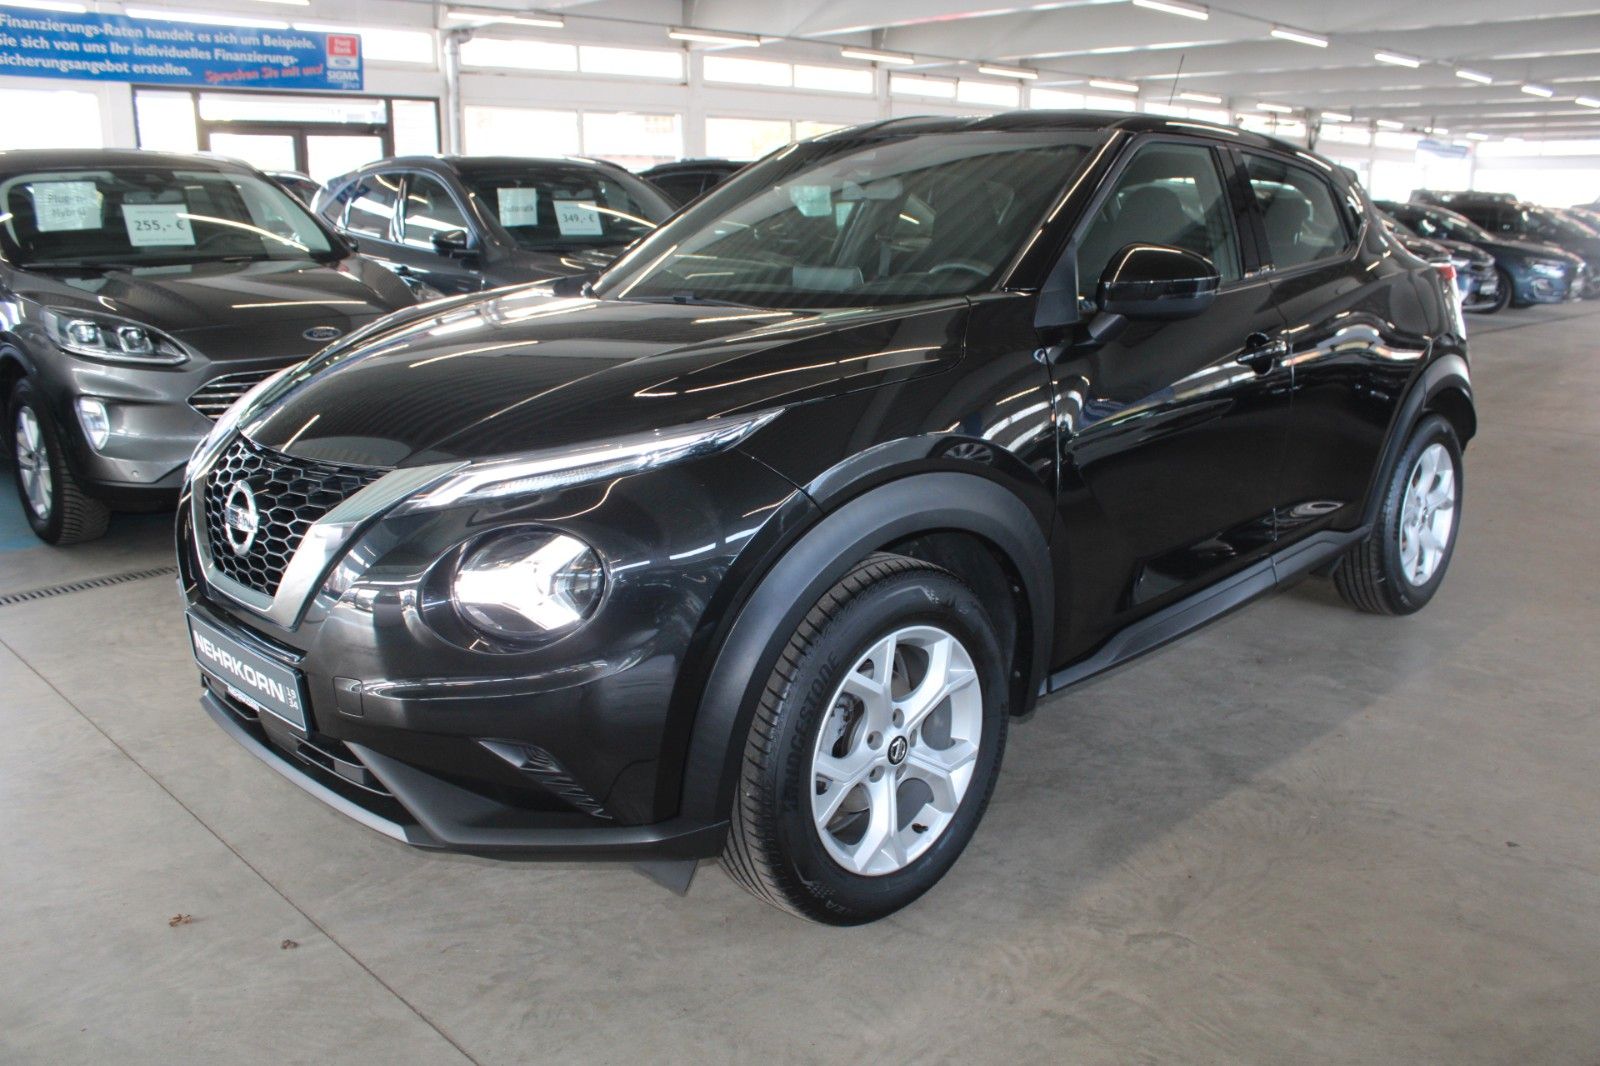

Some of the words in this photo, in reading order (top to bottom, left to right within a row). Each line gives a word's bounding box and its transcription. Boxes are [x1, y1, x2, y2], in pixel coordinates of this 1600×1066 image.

[146, 26, 195, 42] handelt
[197, 33, 211, 43] es
[213, 32, 237, 45] sich
[240, 36, 260, 46] um
[263, 34, 316, 50] Beispiele.
[20, 35, 50, 49] sich
[52, 41, 80, 52] von
[83, 43, 108, 54] uns
[110, 43, 130, 55] Ihr
[134, 44, 211, 61] individuelles
[214, 48, 299, 67] Finanzierungs-
[132, 64, 192, 76] erstellen.
[134, 219, 172, 232] 255,-
[176, 219, 186, 231] €
[193, 630, 286, 703] NEHRKORN
